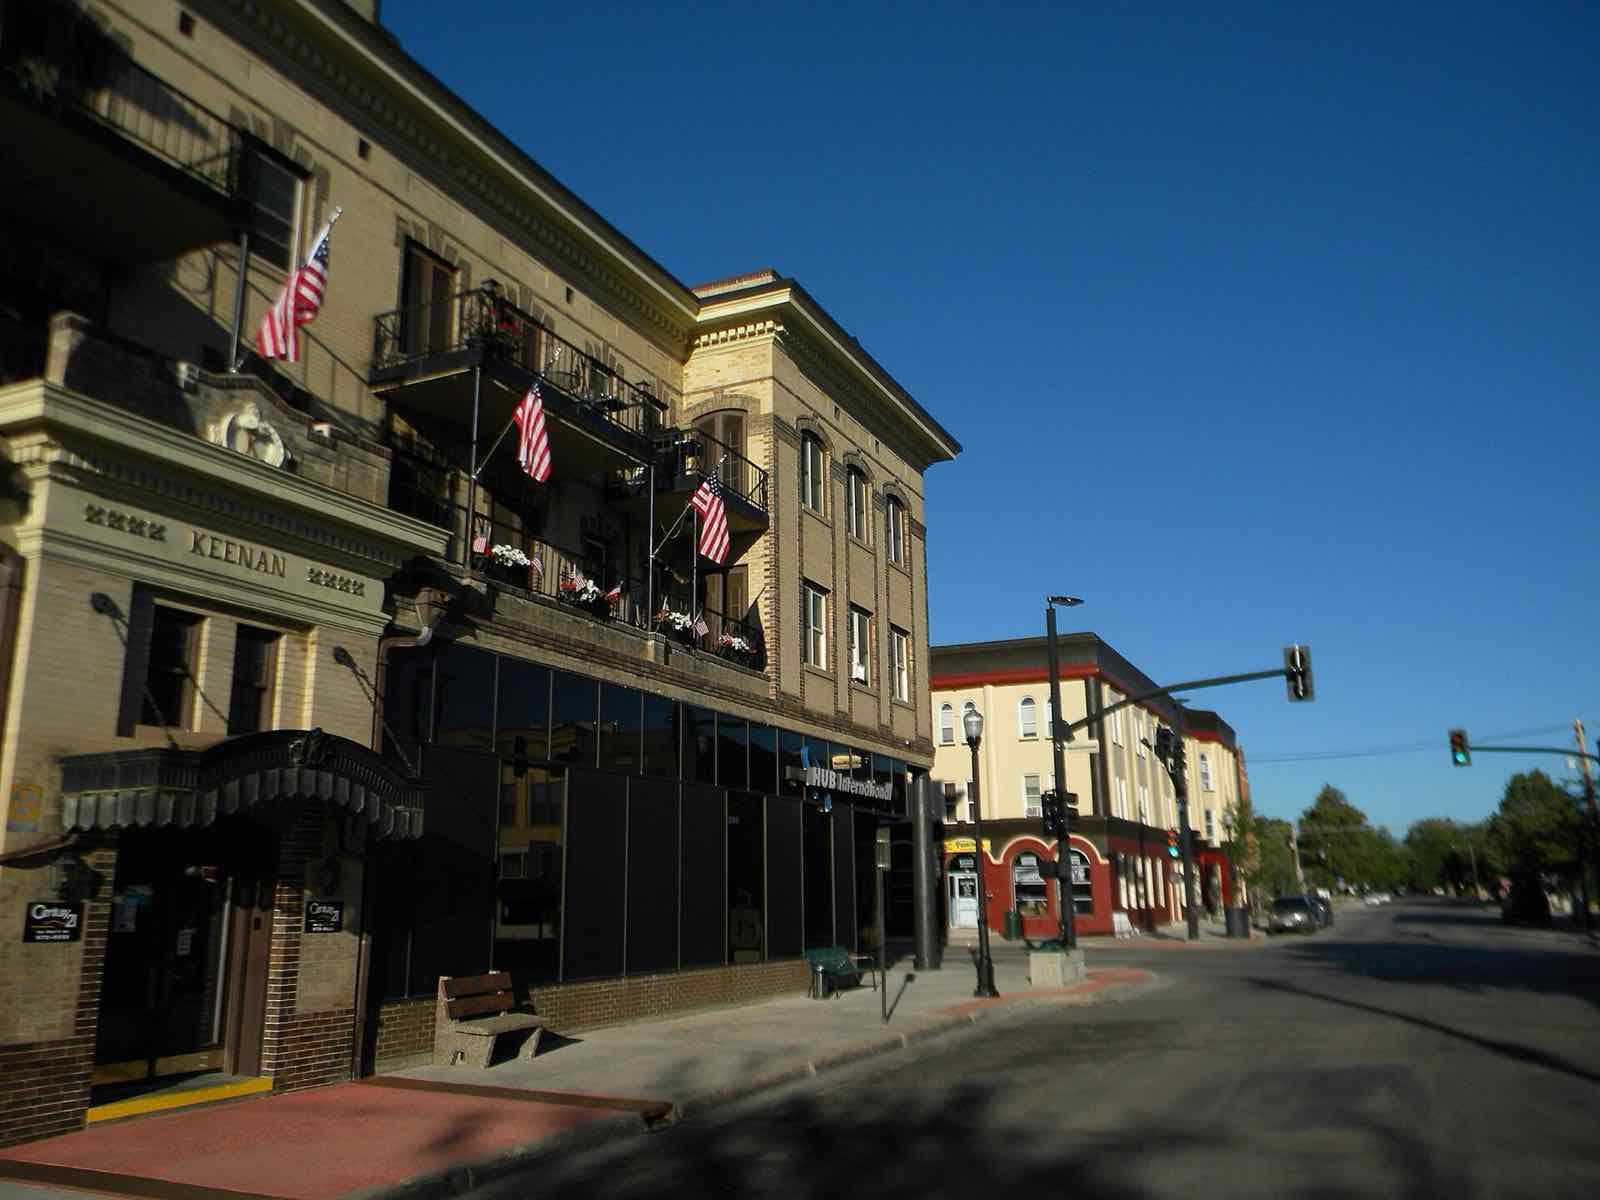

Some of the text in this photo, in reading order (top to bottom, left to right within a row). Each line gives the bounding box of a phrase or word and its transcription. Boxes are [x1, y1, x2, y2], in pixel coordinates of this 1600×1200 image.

[191, 530, 286, 578] KEENAN
[814, 768, 837, 789] HUB
[32, 904, 72, 920] Century
